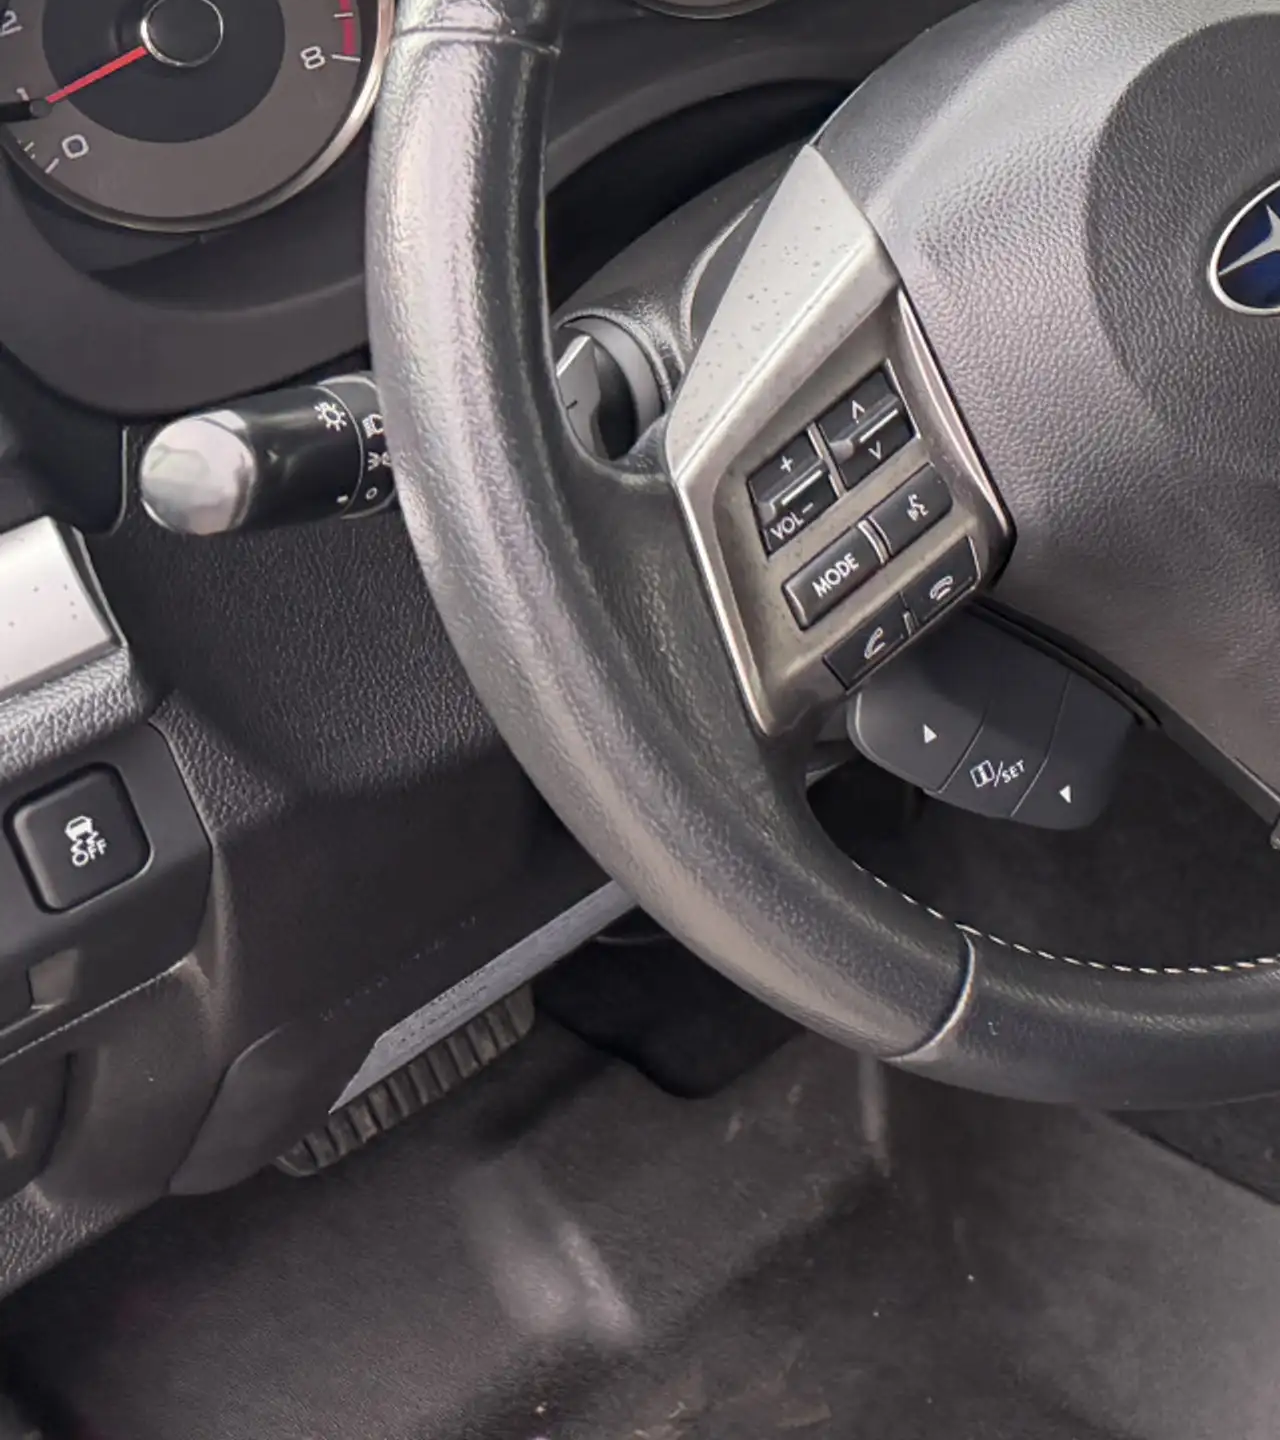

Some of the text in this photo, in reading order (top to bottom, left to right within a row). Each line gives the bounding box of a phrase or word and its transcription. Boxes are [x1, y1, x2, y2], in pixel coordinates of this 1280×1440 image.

[299, 45, 327, 70] 8
[61, 133, 90, 160] 0
[770, 511, 804, 540] VOL
[811, 551, 860, 599] MODE
[72, 838, 107, 868] OFF
